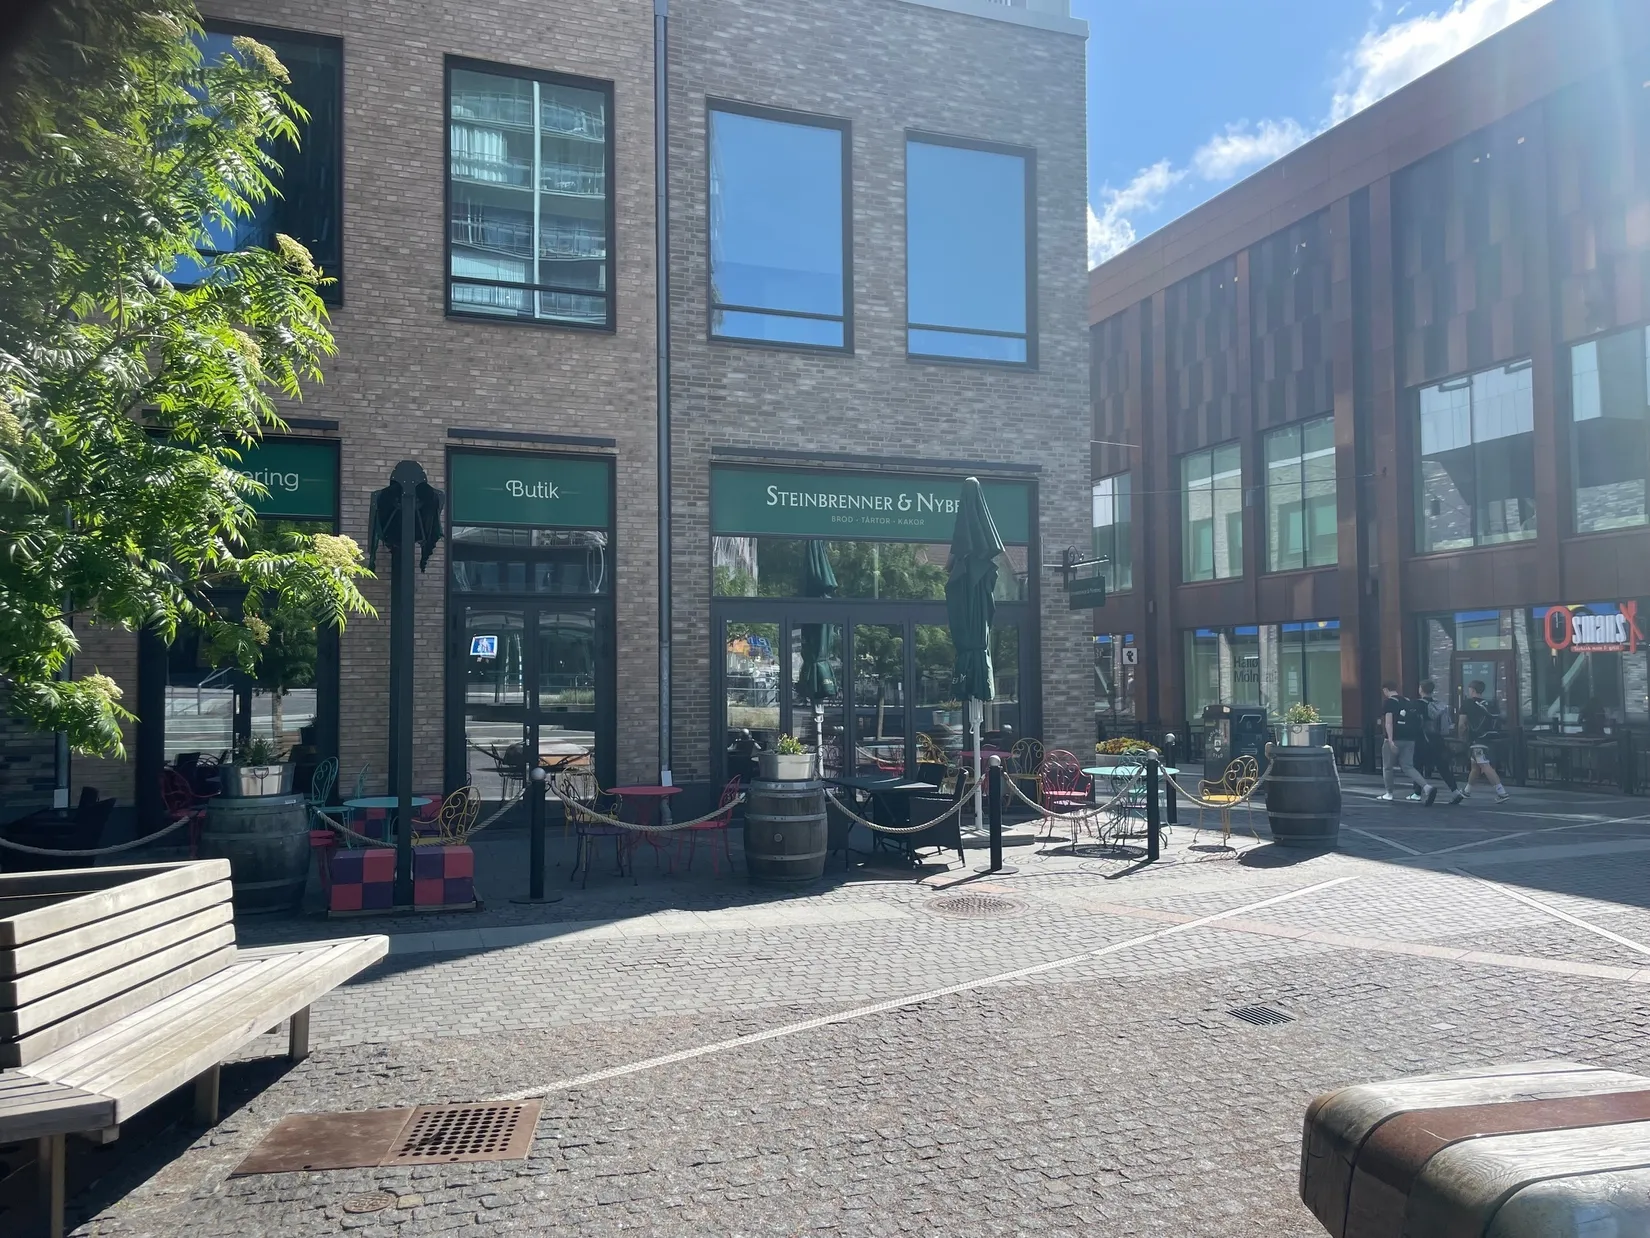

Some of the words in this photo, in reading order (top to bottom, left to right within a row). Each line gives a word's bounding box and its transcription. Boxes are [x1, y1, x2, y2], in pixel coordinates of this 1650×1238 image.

[505, 480, 559, 499] Butik
[766, 485, 893, 511] STEINBRENNER
[897, 493, 912, 511] &
[897, 518, 925, 526] KAKOR
